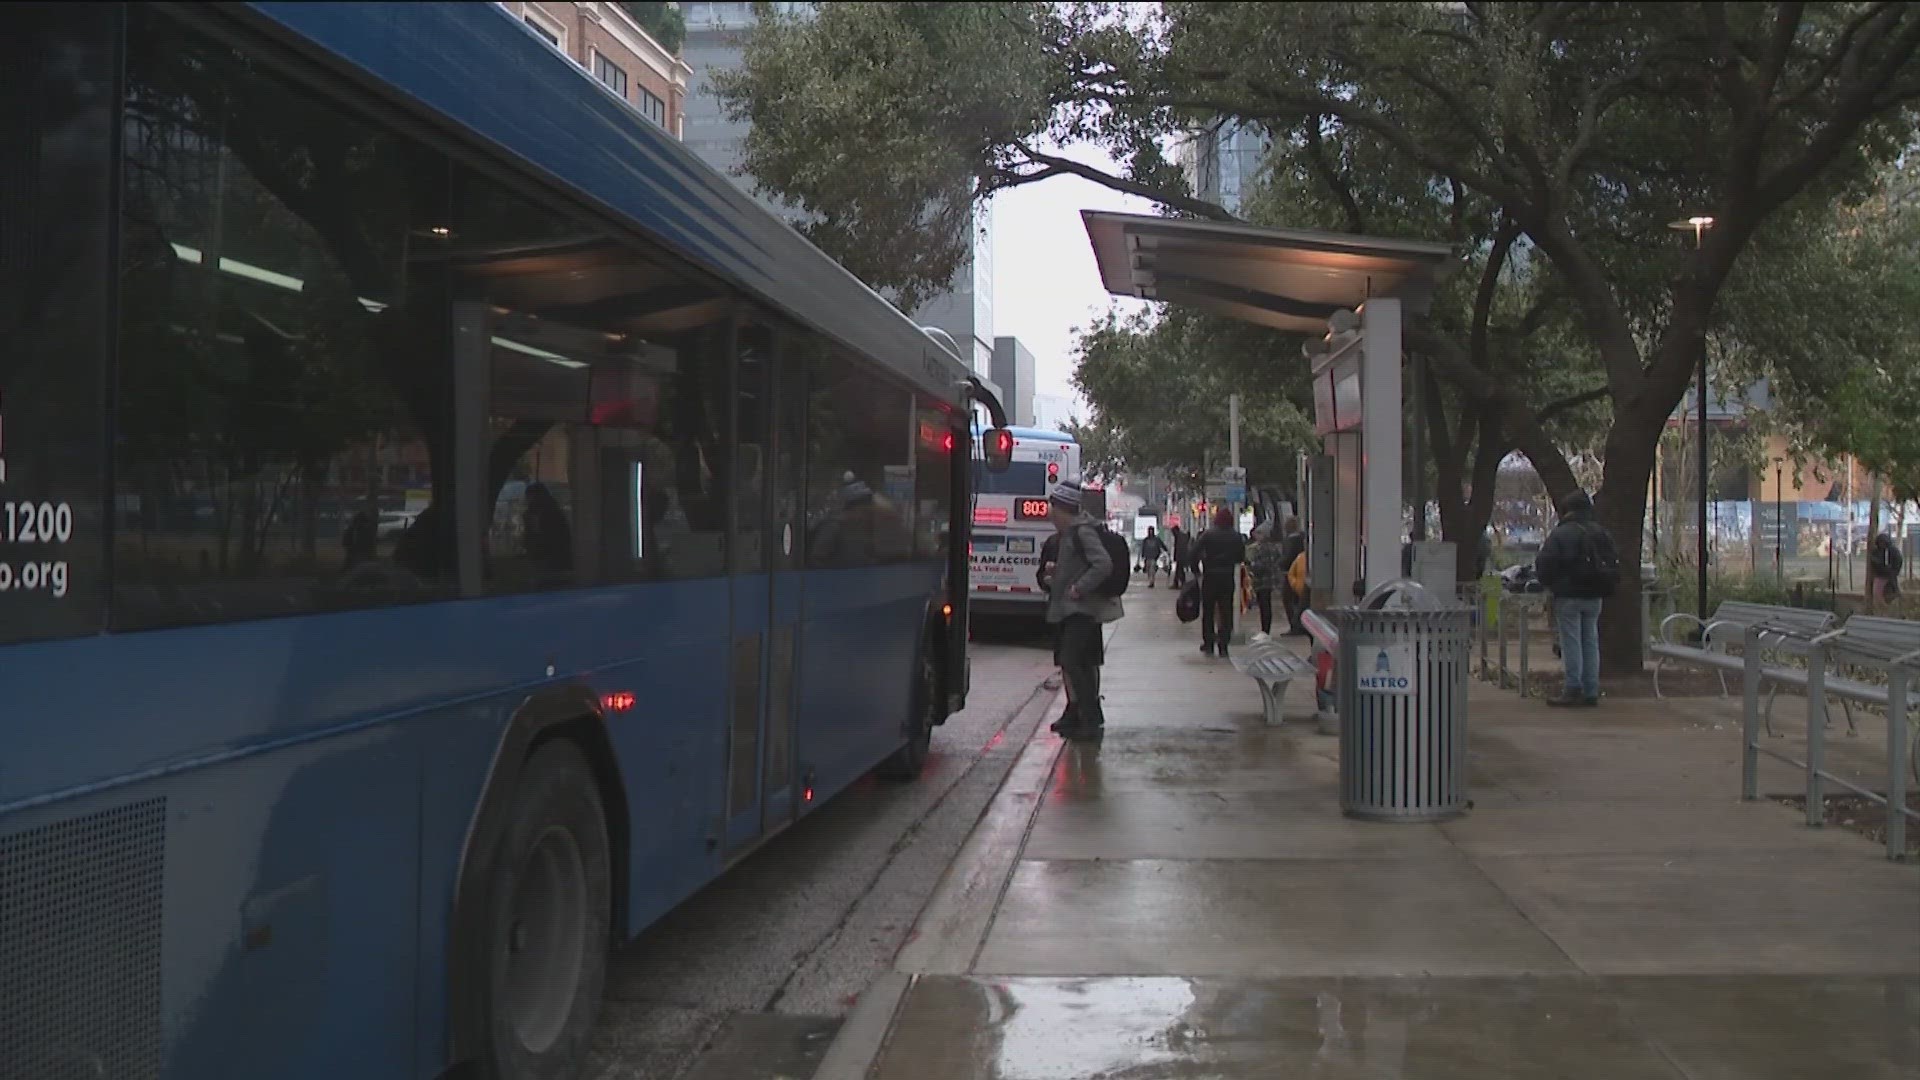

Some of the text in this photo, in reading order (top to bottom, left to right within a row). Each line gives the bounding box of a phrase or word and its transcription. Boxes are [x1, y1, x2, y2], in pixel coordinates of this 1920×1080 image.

[1023, 500, 1048, 516] 803
[0, 501, 72, 543] 1200
[981, 555, 996, 564] AN
[1360, 677, 1408, 688] METRO
